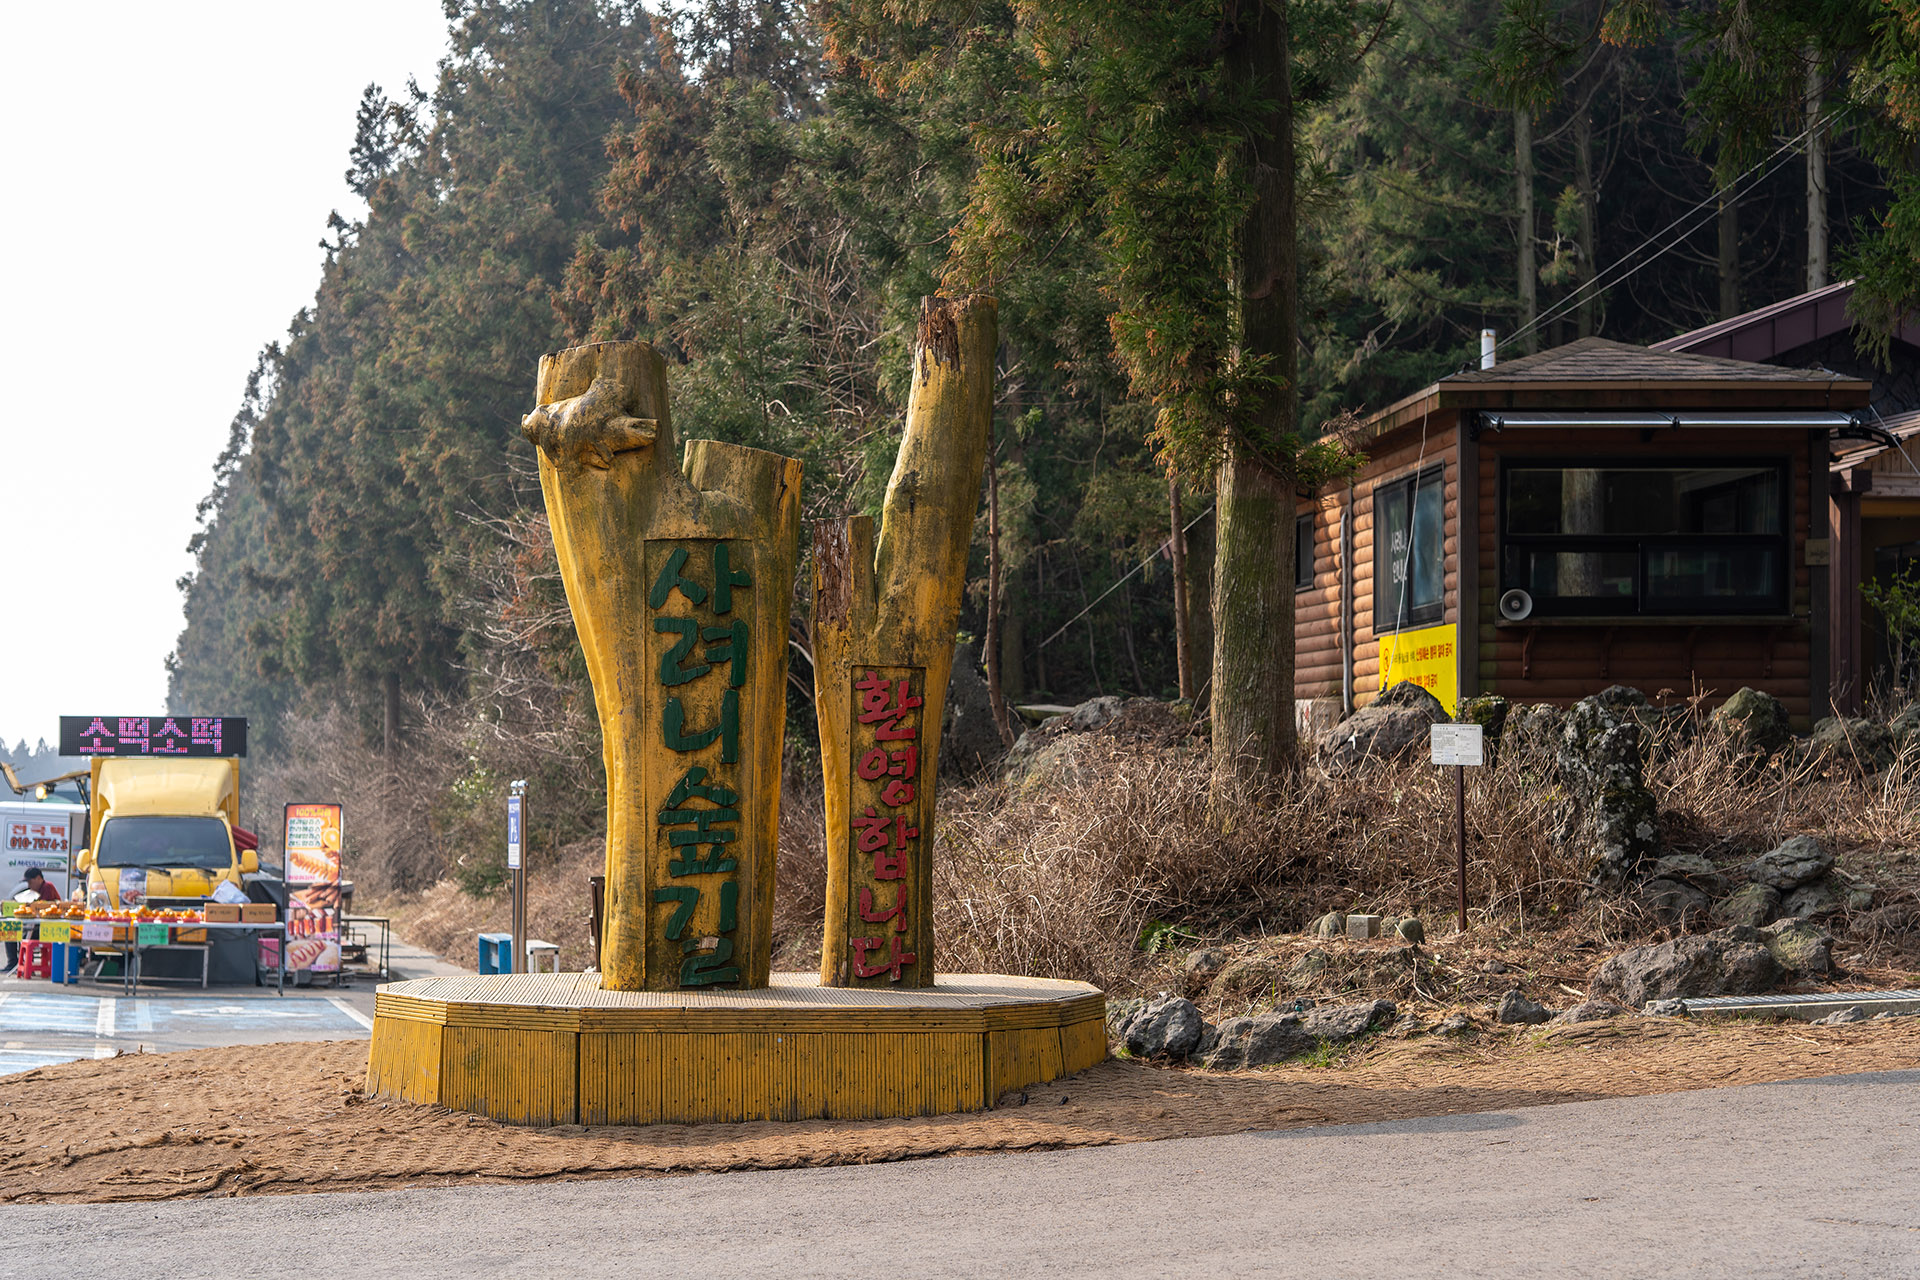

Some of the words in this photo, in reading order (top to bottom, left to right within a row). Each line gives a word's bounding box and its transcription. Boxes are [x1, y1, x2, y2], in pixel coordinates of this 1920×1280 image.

[79, 717, 222, 754] 소떡소떡
[649, 543, 752, 986] 사려니숲길
[852, 671, 922, 981] 환영합니다
